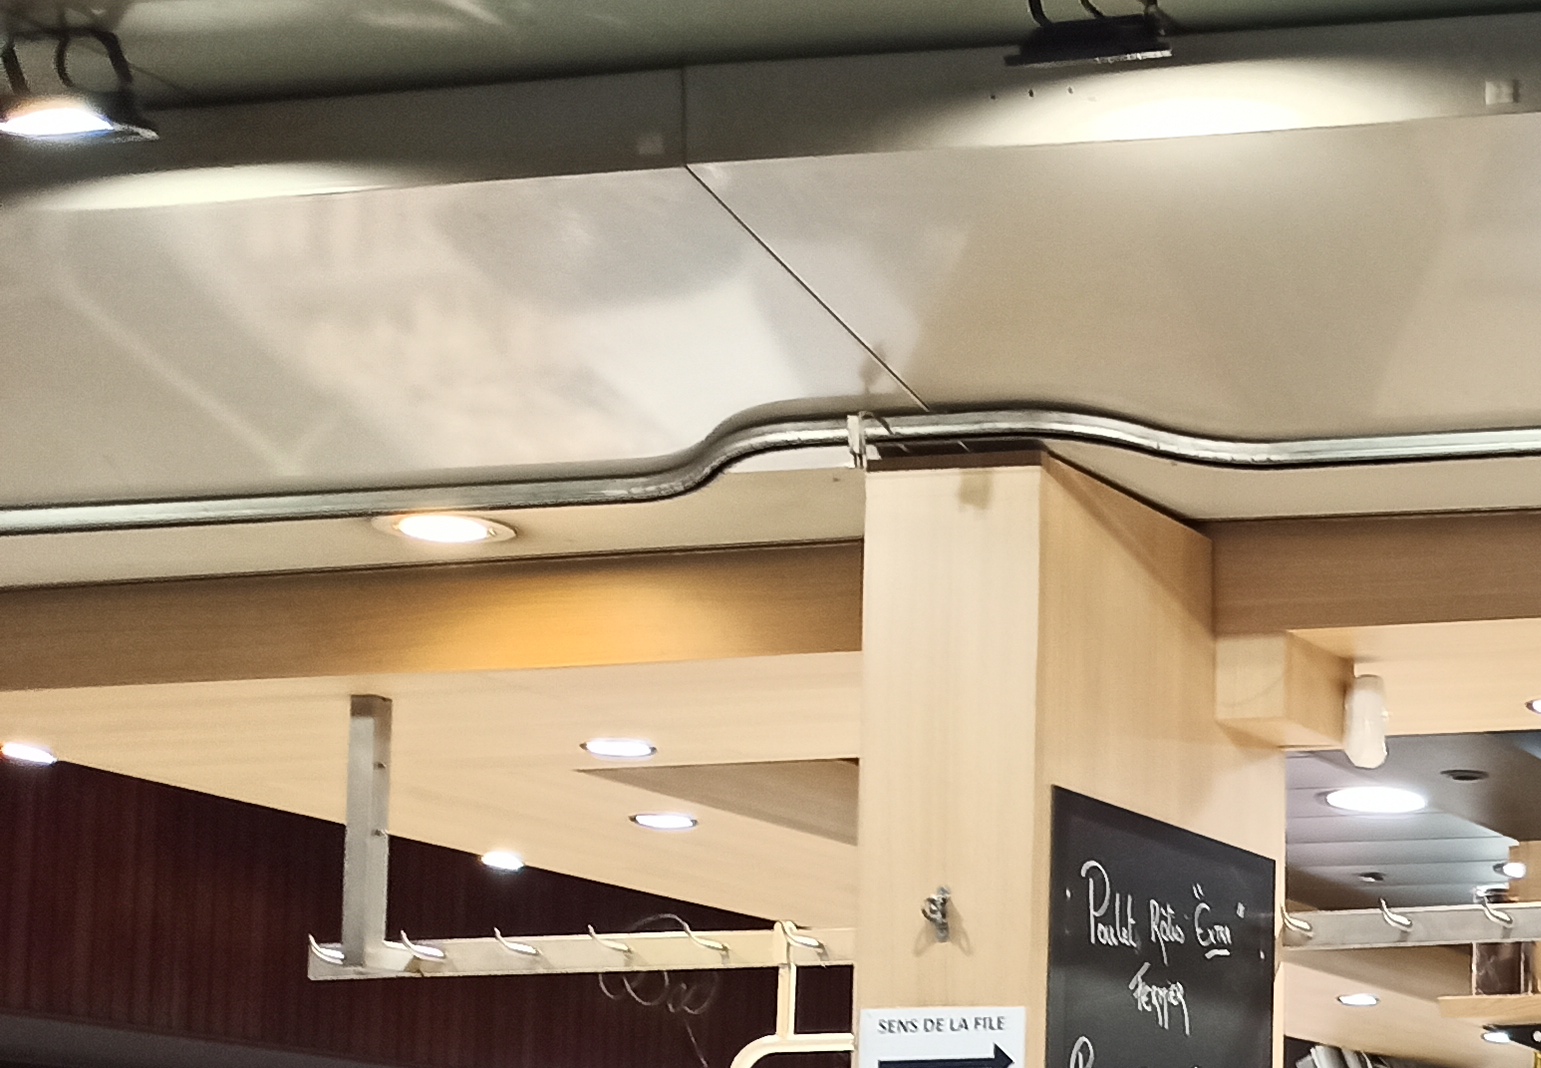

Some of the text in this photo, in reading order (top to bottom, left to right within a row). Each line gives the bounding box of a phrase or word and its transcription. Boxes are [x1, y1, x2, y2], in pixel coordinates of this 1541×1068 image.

[877, 1015, 1006, 1035] SENS DE LA FILE
